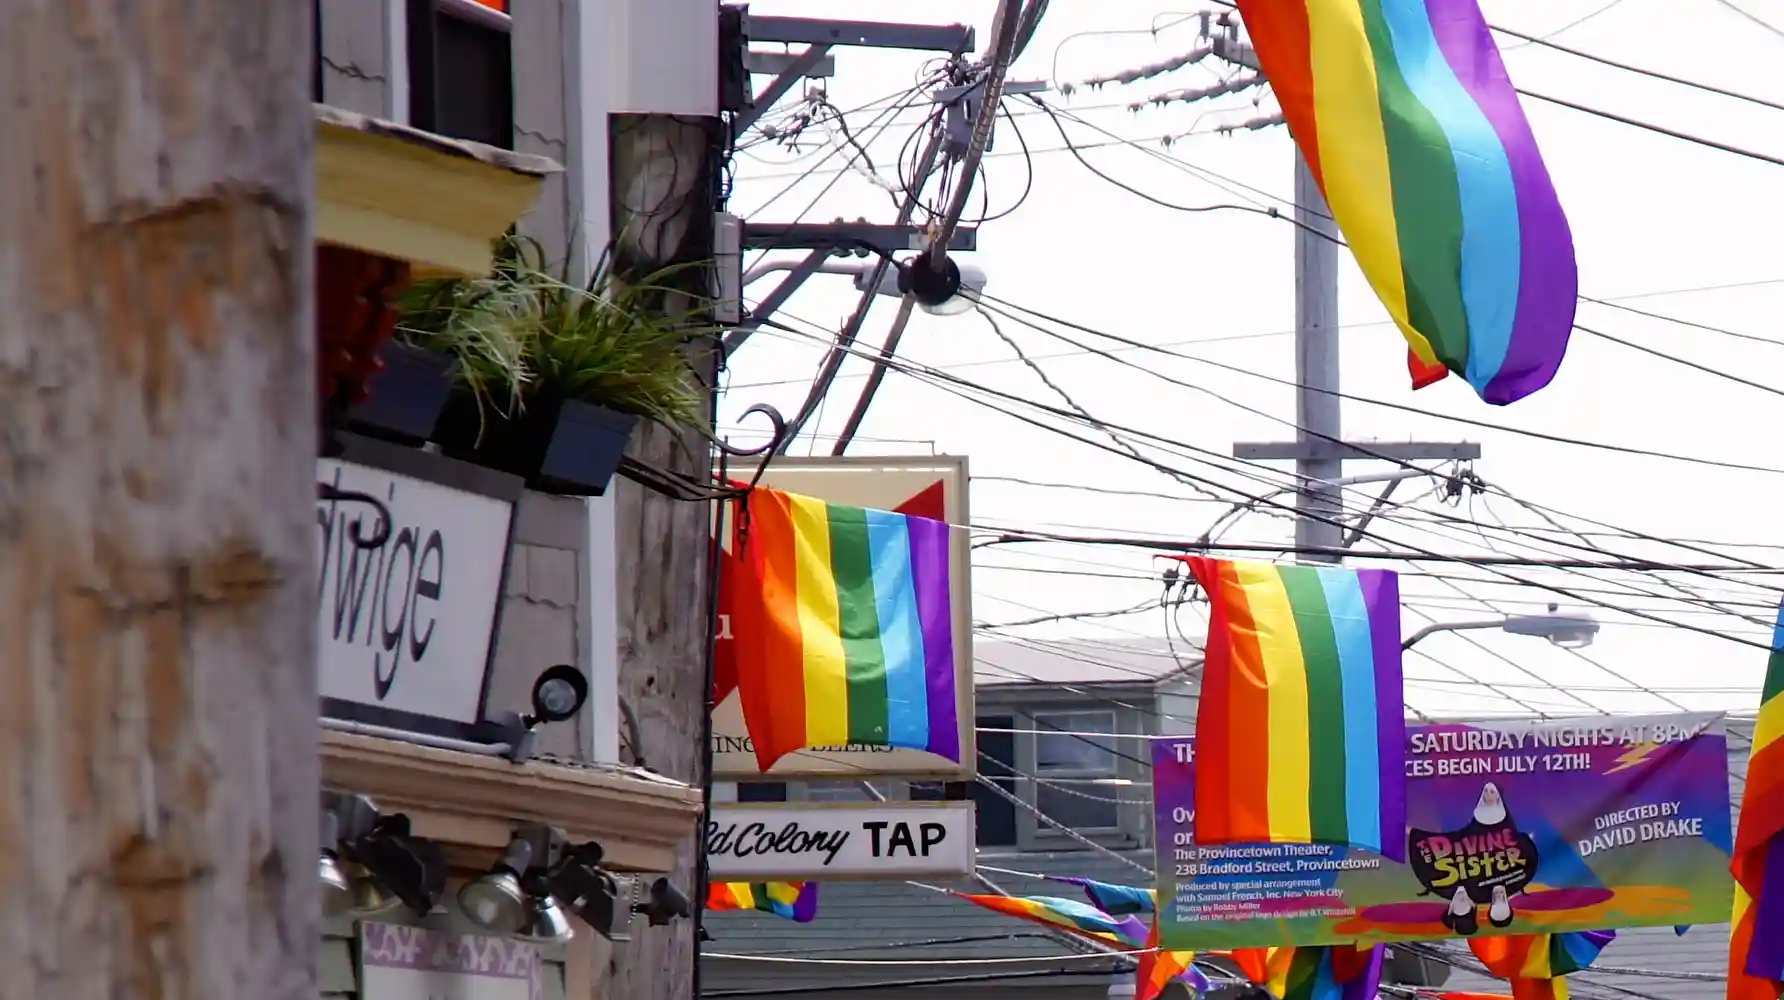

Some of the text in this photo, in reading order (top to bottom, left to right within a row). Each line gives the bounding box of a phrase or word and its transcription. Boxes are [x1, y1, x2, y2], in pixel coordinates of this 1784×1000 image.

[1412, 731, 1526, 754] SATURDAY
[1534, 723, 1613, 748] NIGHTS
[1620, 722, 1647, 745] AT
[1438, 758, 1491, 775] BEGIN
[1496, 755, 1537, 773] JULY
[1542, 753, 1591, 771] 12TH!
[1594, 801, 1681, 830] DIRECTED BY
[734, 822, 850, 866] Colony
[863, 822, 946, 857] TAP
[1174, 844, 1333, 860] The Provincetown Theater,
[1578, 818, 1703, 857] DAVID DRAKE
[1175, 858, 1379, 877] 238 Bradford Street, Provincetown
[1305, 888, 1325, 898] York
